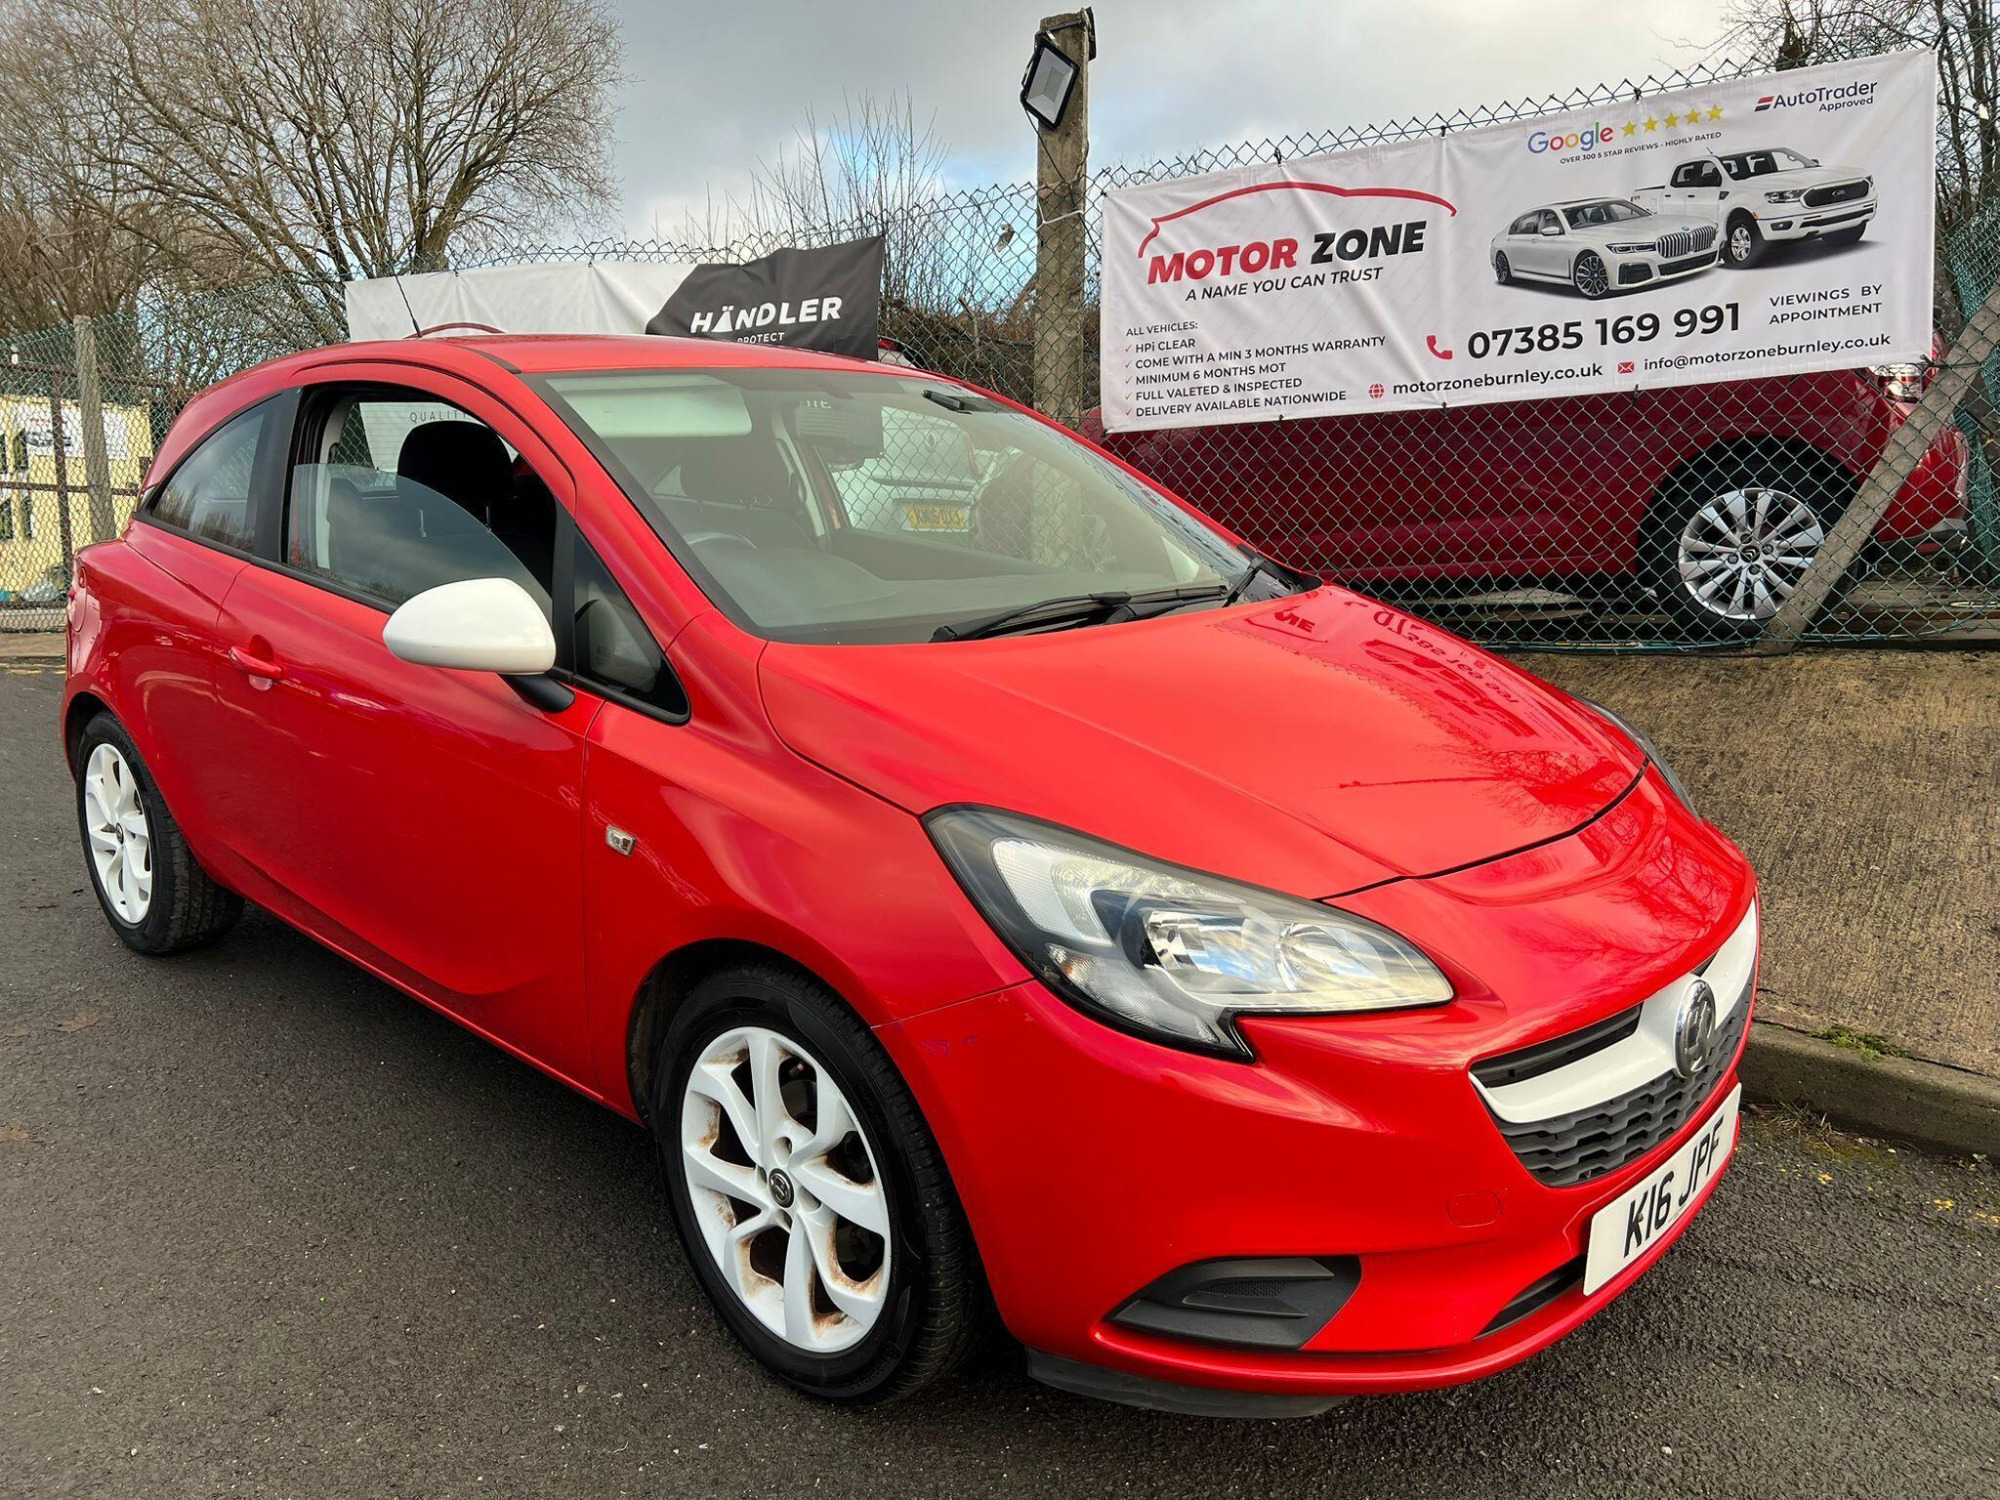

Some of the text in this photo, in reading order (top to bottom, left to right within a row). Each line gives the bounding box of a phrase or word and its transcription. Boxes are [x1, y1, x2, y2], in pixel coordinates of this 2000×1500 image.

[1773, 81, 1878, 109] AutoTrader
[1818, 96, 1873, 112] Approved
[1527, 122, 1614, 154] Google
[1560, 155, 1580, 164] OVER
[1582, 153, 1596, 161] 300
[1603, 149, 1623, 158] STAR
[1624, 142, 1659, 155] REVIEWS
[1665, 137, 1693, 147] HIGHLY
[1695, 131, 1722, 143] RATED
[1148, 220, 1427, 284] MOTOR ZONE
[1185, 266, 1383, 301] A NAME YOU CAN TRUST
[1769, 284, 1883, 307] VIEWINGS BY
[690, 296, 843, 333] HÄNDLER
[1126, 321, 1198, 337] ALL VEHICLES:
[1769, 302, 1883, 325] APPOINTMENT
[1135, 338, 1196, 354] HPi CLEAR
[1468, 302, 1740, 359] 07385 169 991
[1135, 336, 1386, 369] COME WITH A MIN 3 MONTHS WARRANTY
[1644, 334, 1891, 371] info@motorzoneburnley.co.uk
[1135, 362, 1287, 385] MINIMUM 6 MONTHS MOT
[1136, 378, 1303, 401] FULL VALETED & INSPECTED
[1393, 363, 1604, 395] motorzoneburnley.co.uk
[1136, 391, 1347, 417] DELIVERY AVAILABLE NATIONWIDE
[1624, 1114, 1724, 1259] K16 JPF
